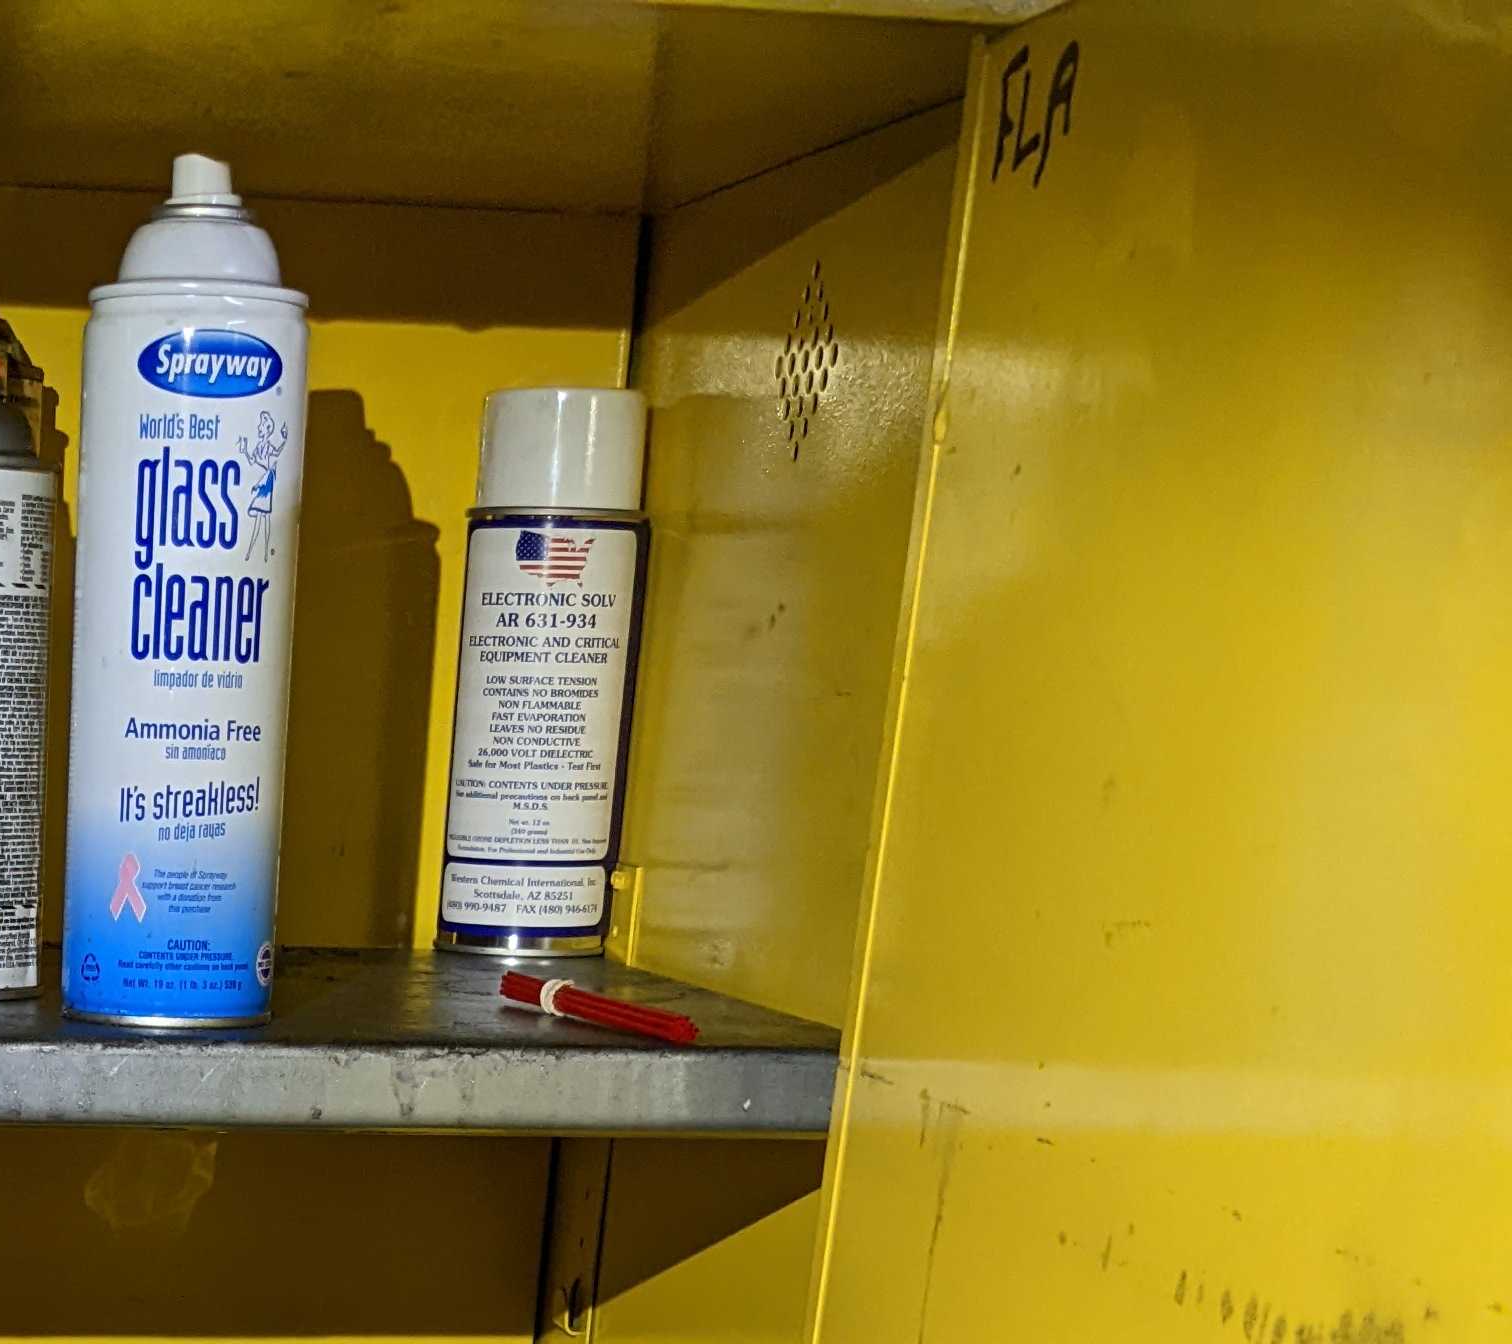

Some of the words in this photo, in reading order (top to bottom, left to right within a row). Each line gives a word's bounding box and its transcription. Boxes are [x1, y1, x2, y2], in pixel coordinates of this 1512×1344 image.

[156, 344, 272, 386] Sprayway
[140, 413, 185, 440] World's
[190, 415, 220, 440] Best
[135, 446, 240, 570] glass
[482, 592, 576, 606] ELECTRONIC
[581, 594, 616, 607] SOLV
[131, 563, 270, 664] cleaner
[496, 613, 518, 627] AR
[526, 613, 596, 628] 631-934
[470, 636, 537, 647] ELECTRONIC
[543, 638, 570, 648] AND
[575, 638, 620, 648] CRITICAL
[480, 652, 550, 663] EQUIPMENT
[555, 652, 607, 664] CLEANER
[487, 676, 506, 684] LOW
[510, 676, 553, 685] SURFACE
[558, 677, 597, 685] TENSION
[483, 688, 529, 697] CONTAINS
[533, 689, 547, 697] NO
[499, 701, 519, 709] NON
[523, 701, 581, 710] FLAMMABLE
[492, 712, 514, 721] FAST
[518, 713, 586, 722] EVAPORATION
[125, 717, 220, 741] Ammonia
[227, 720, 261, 741] Free
[490, 724, 524, 733] LEAVES
[528, 725, 542, 733] NO
[493, 737, 513, 745] NON
[166, 745, 179, 759] sin
[120, 786, 145, 822] It's
[153, 777, 260, 820] streakless!
[158, 827, 170, 841] no
